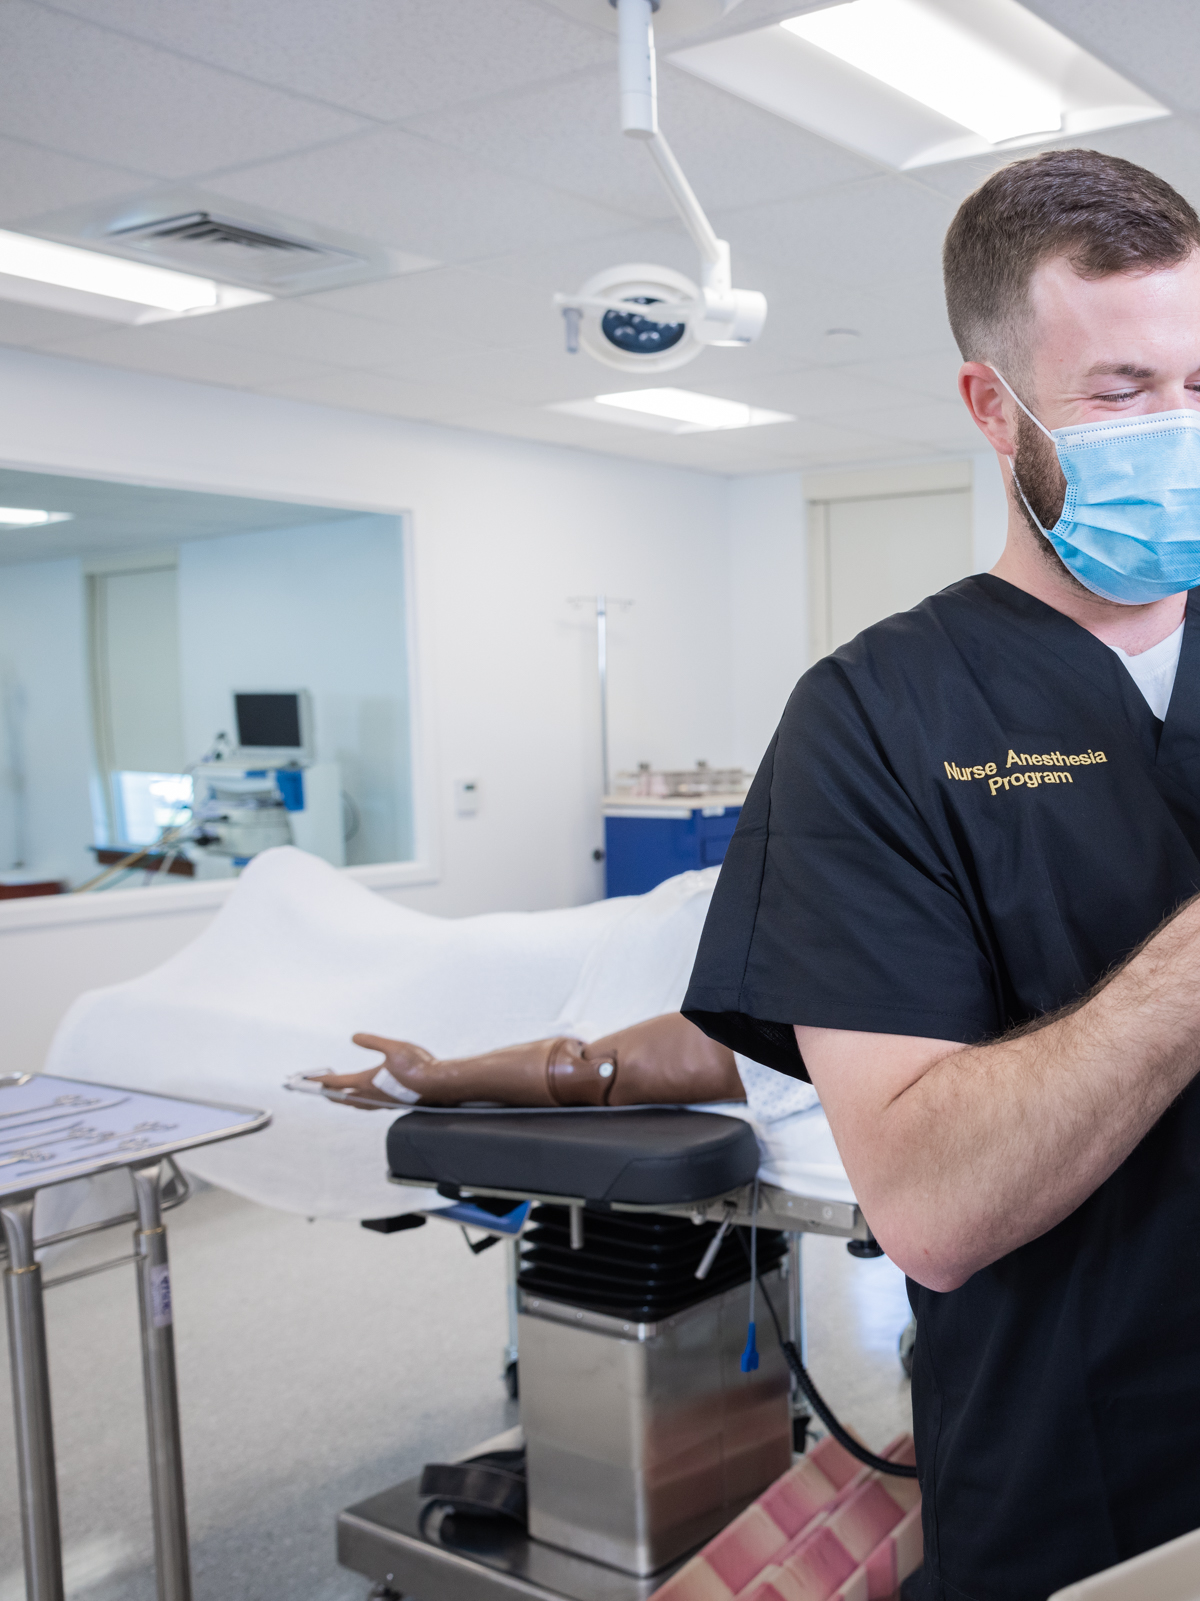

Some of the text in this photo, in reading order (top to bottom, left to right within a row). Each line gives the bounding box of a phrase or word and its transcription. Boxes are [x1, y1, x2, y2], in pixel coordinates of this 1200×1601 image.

[943, 749, 1108, 781] Nurse Anesthesia
[988, 771, 1074, 796] Program
